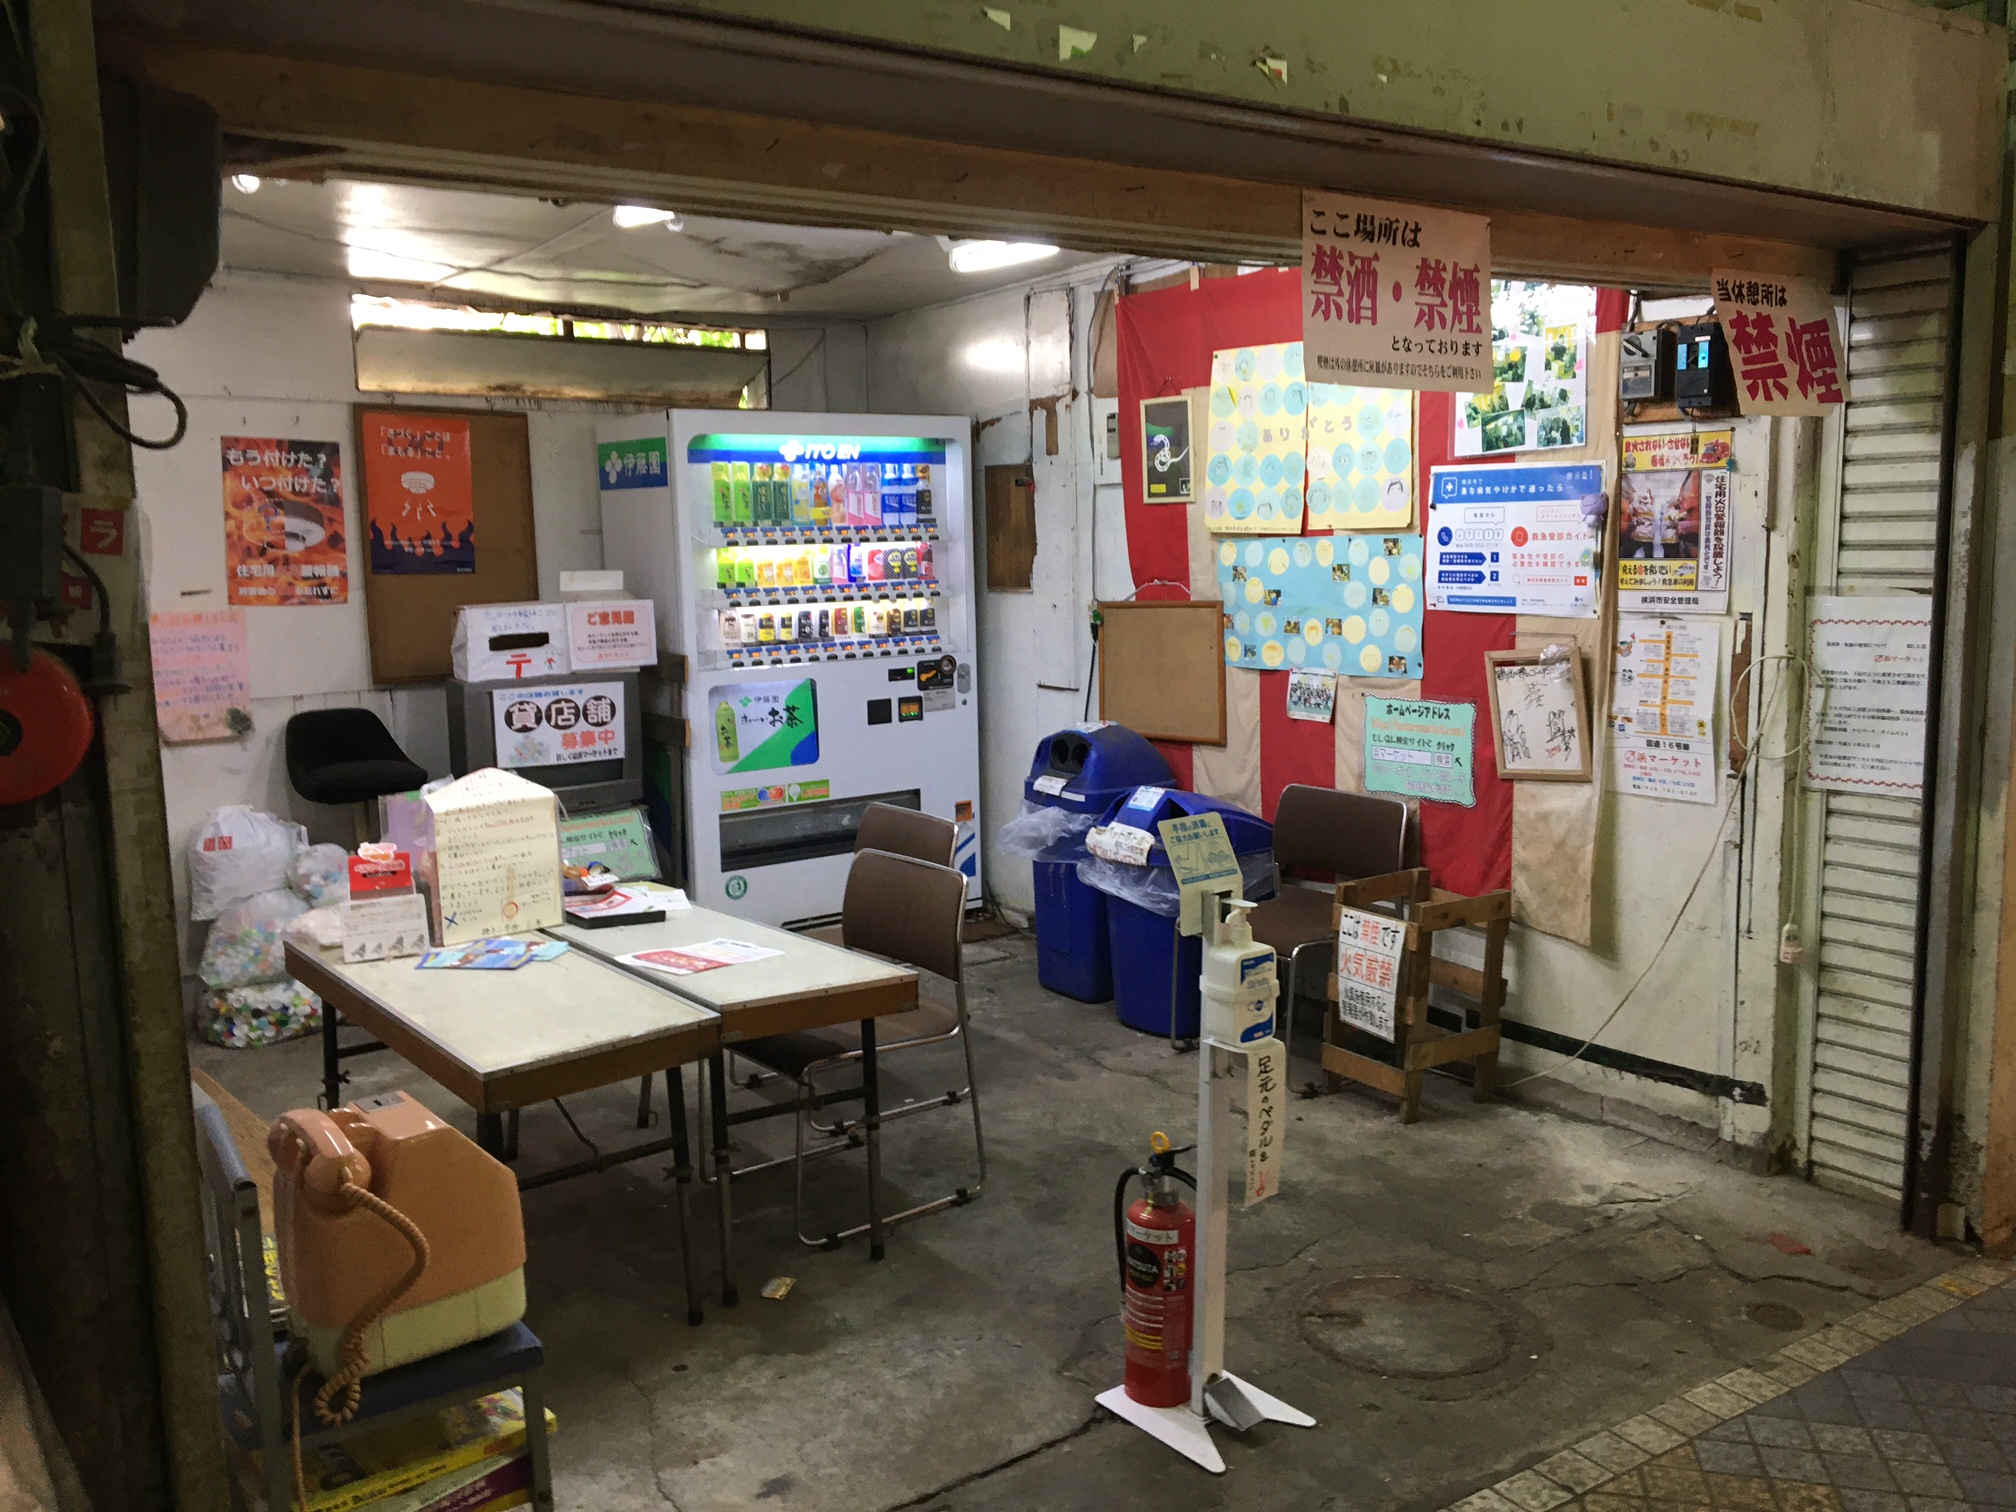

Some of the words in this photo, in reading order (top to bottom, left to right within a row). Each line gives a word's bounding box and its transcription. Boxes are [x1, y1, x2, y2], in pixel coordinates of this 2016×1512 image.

[1310, 209, 1422, 248] ここ場所は
[1310, 243, 1483, 335] 禁酒・禁煙
[1716, 277, 1788, 308] 当休憩所は
[1390, 335, 1484, 357] となっております
[1728, 310, 1845, 404] 禁煙
[622, 450, 661, 477] 伊藤園
[804, 443, 833, 461] ITO
[837, 443, 861, 461] EN
[507, 697, 613, 731] 貸店舗
[1386, 703, 1451, 720] ホームページアドレス
[561, 729, 616, 750] 募集中
[1339, 948, 1393, 988] 火気厳禁
